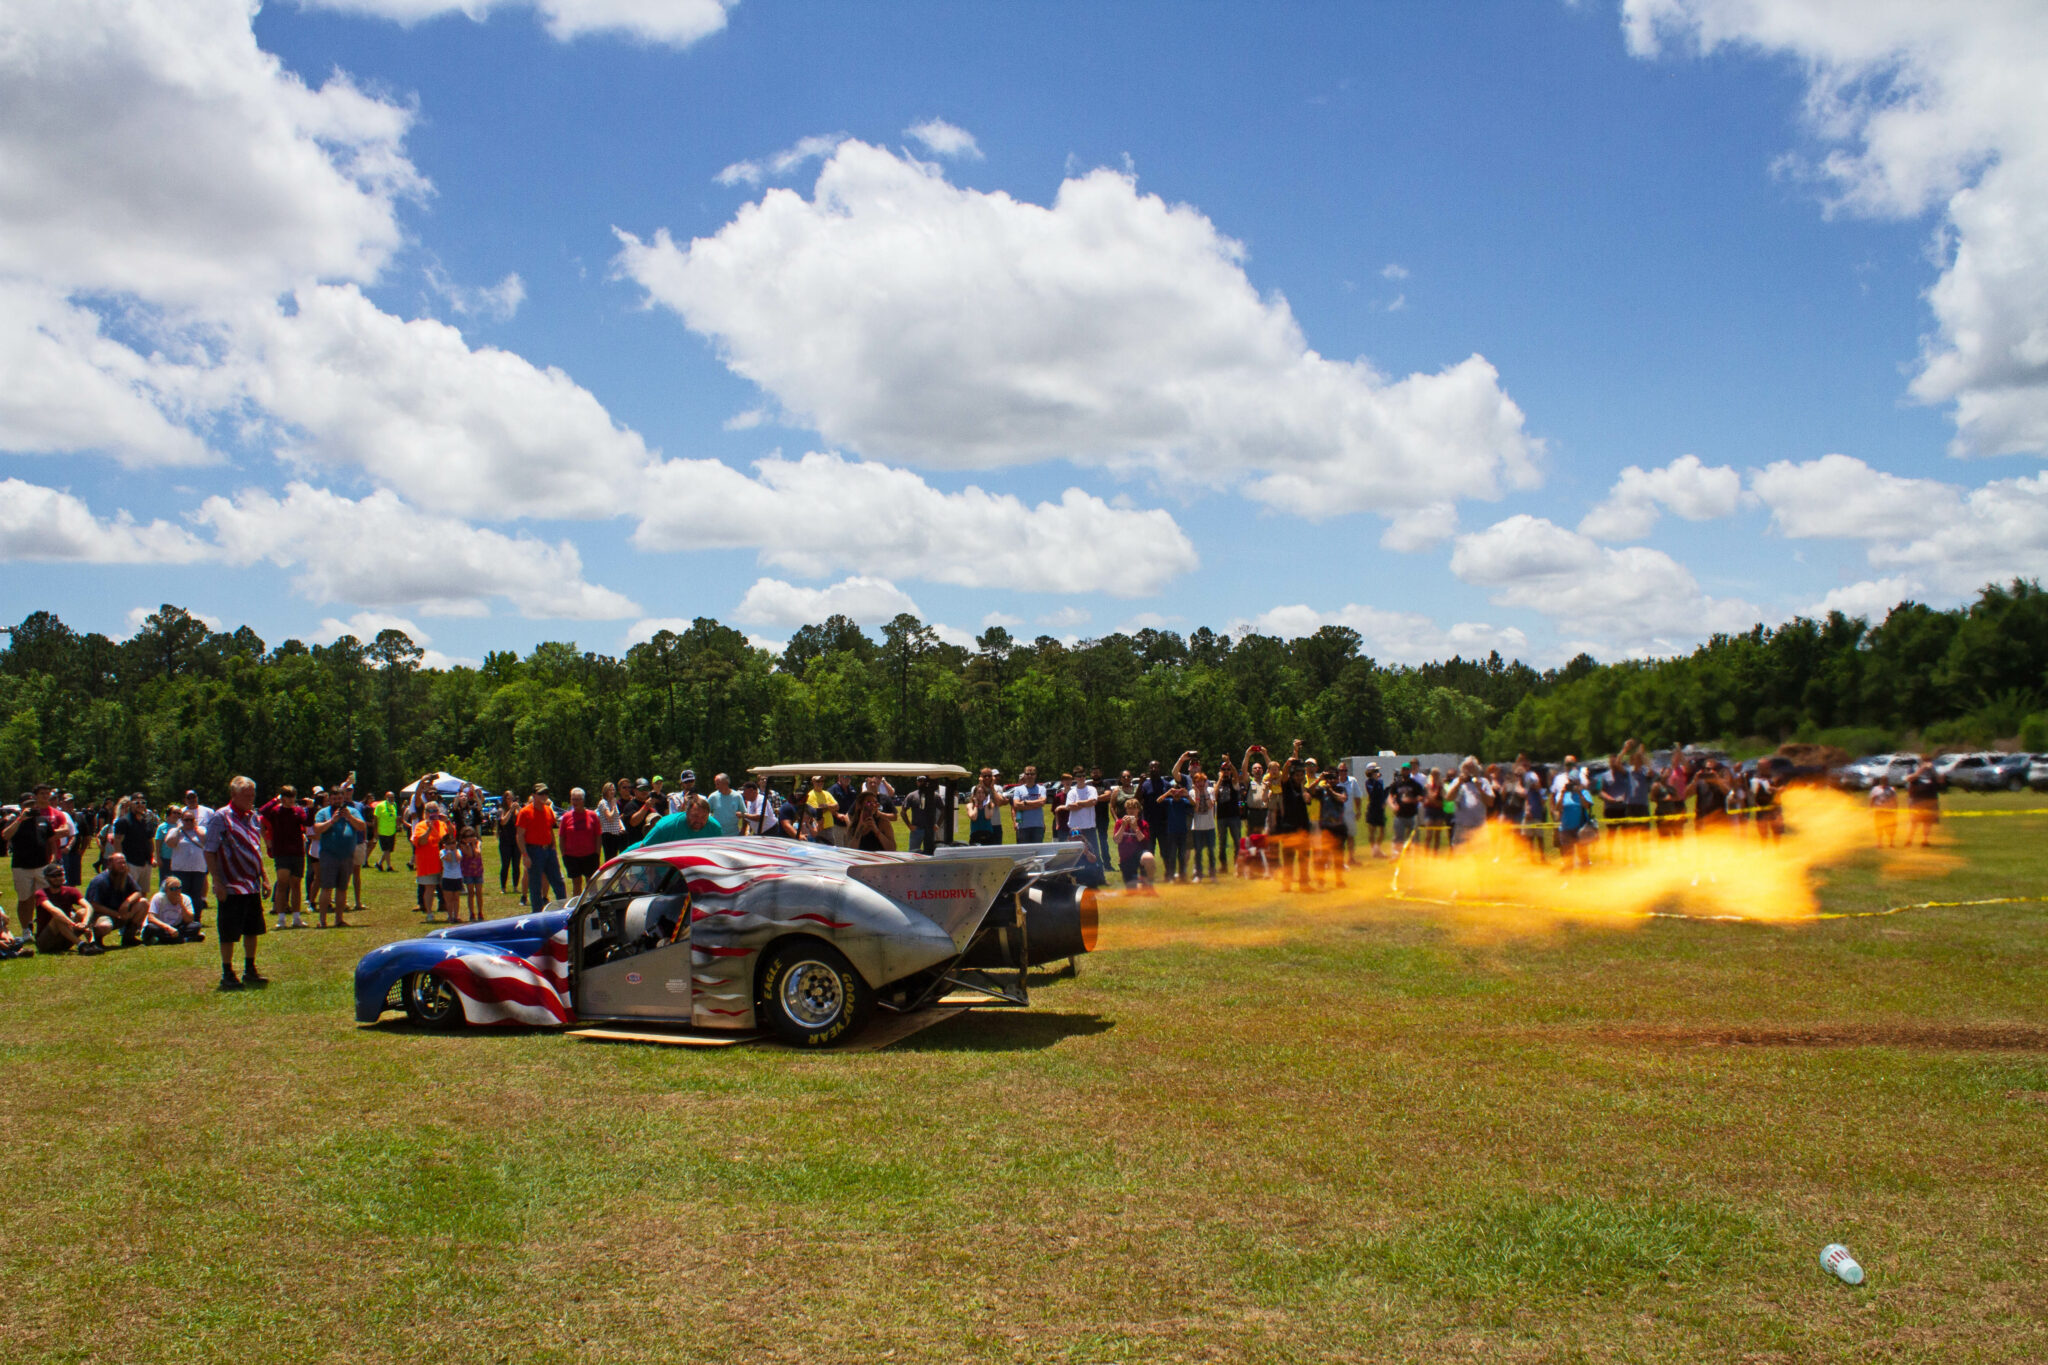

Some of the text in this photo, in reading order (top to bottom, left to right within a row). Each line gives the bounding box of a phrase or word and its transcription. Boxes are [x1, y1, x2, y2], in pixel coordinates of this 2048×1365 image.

[906, 888, 976, 900] FLASHDRIVE
[764, 959, 782, 1000] EAGLE
[808, 973, 856, 1044] GOODYEAR
